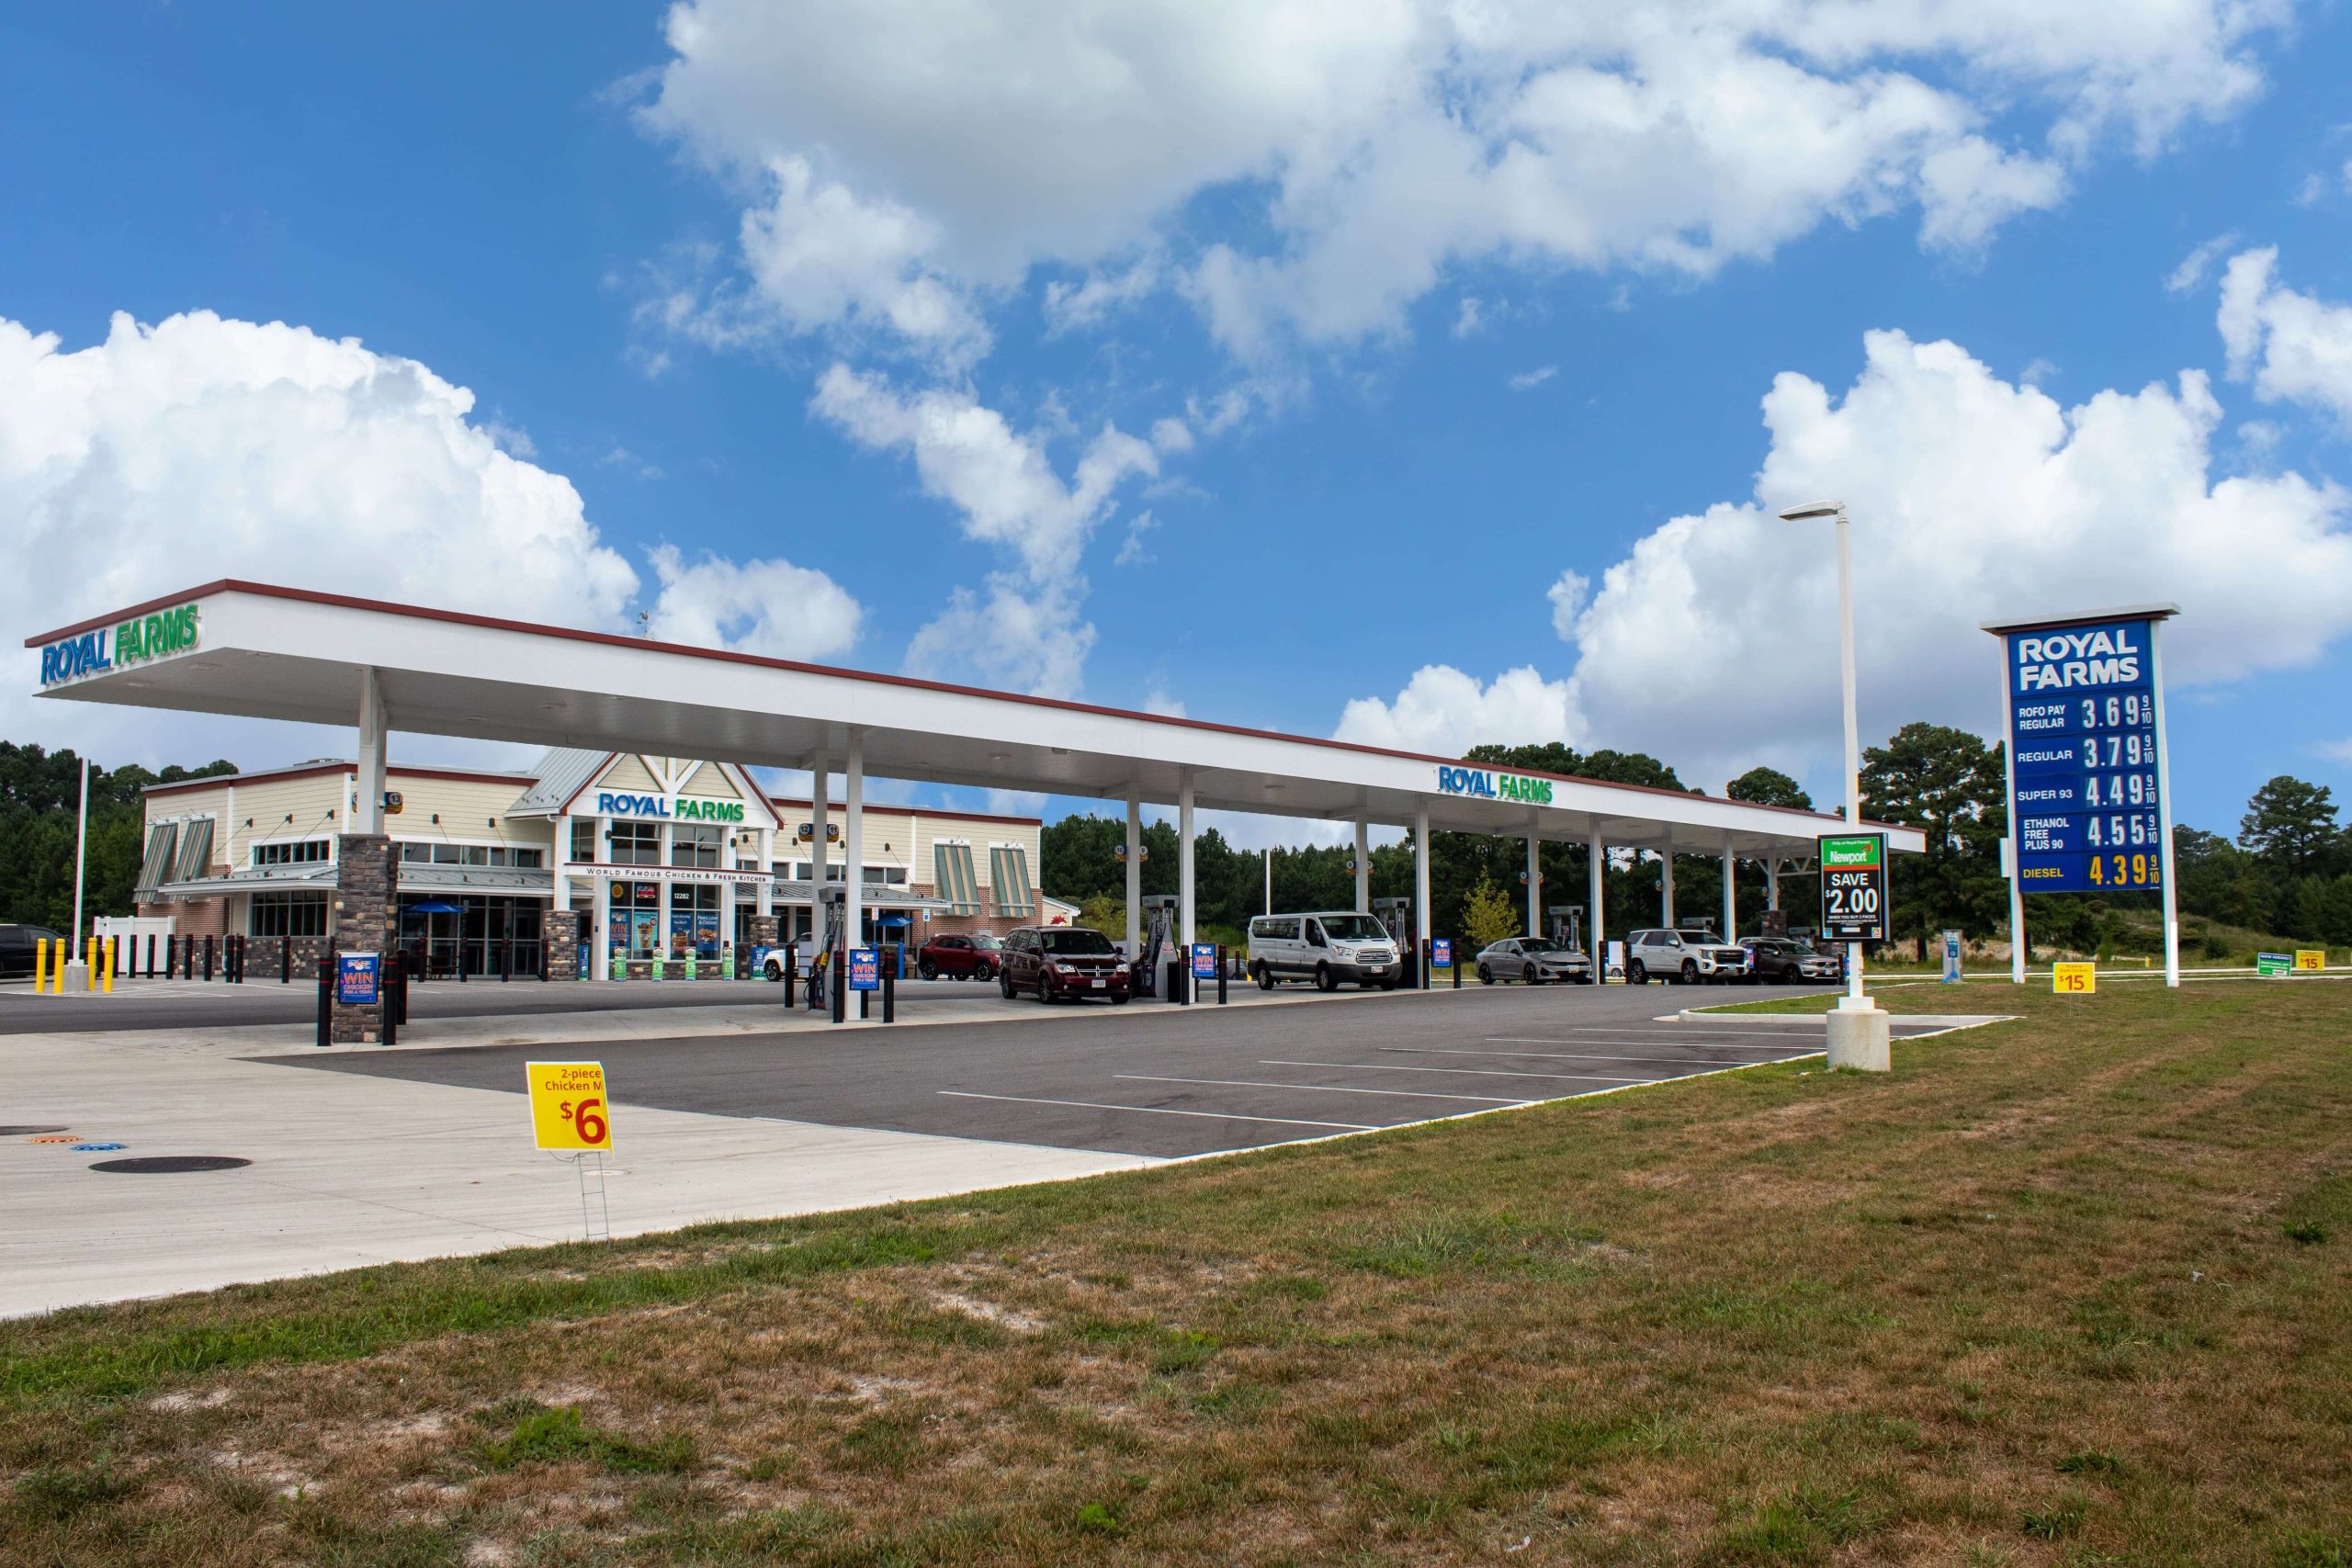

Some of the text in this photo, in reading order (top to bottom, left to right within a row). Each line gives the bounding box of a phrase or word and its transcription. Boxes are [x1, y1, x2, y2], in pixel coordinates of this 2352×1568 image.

[40, 604, 198, 684] ROYAL FARMS
[2019, 629, 2138, 663] ROYAL
[2020, 657, 2139, 691] FARMS
[2019, 705, 2065, 717] ROFO PAY
[2082, 695, 2139, 728] 3.69
[2019, 717, 2064, 730] REGULAR
[2018, 750, 2073, 762] REGULAR
[2084, 735, 2141, 768] 3.79
[1439, 766, 1553, 803] ROYAL FARMS
[2086, 774, 2143, 807] 4.49
[391, 795, 401, 803] 13
[2018, 789, 2073, 801] SUPER 93
[598, 793, 744, 821] ROYAL FARMS
[2024, 818, 2069, 829] ETHANOL
[2024, 829, 2049, 840] FREE
[2087, 815, 2144, 846] 4.55
[2025, 839, 2064, 850] PLUS 90
[1830, 851, 1867, 864] Newport
[2023, 868, 2064, 878] DIESEL
[2089, 854, 2146, 886] 4.39
[1831, 873, 1869, 886] SAVE
[1825, 887, 1878, 913] $2.00
[1195, 955, 1213, 964] WIN
[2301, 958, 2318, 969] $15
[853, 964, 876, 973] WIN
[344, 972, 374, 984] WIN
[2059, 975, 2085, 991] $15
[561, 1068, 601, 1081] 2-piece
[545, 1080, 589, 1091] Chicken
[560, 1099, 606, 1145] $6
